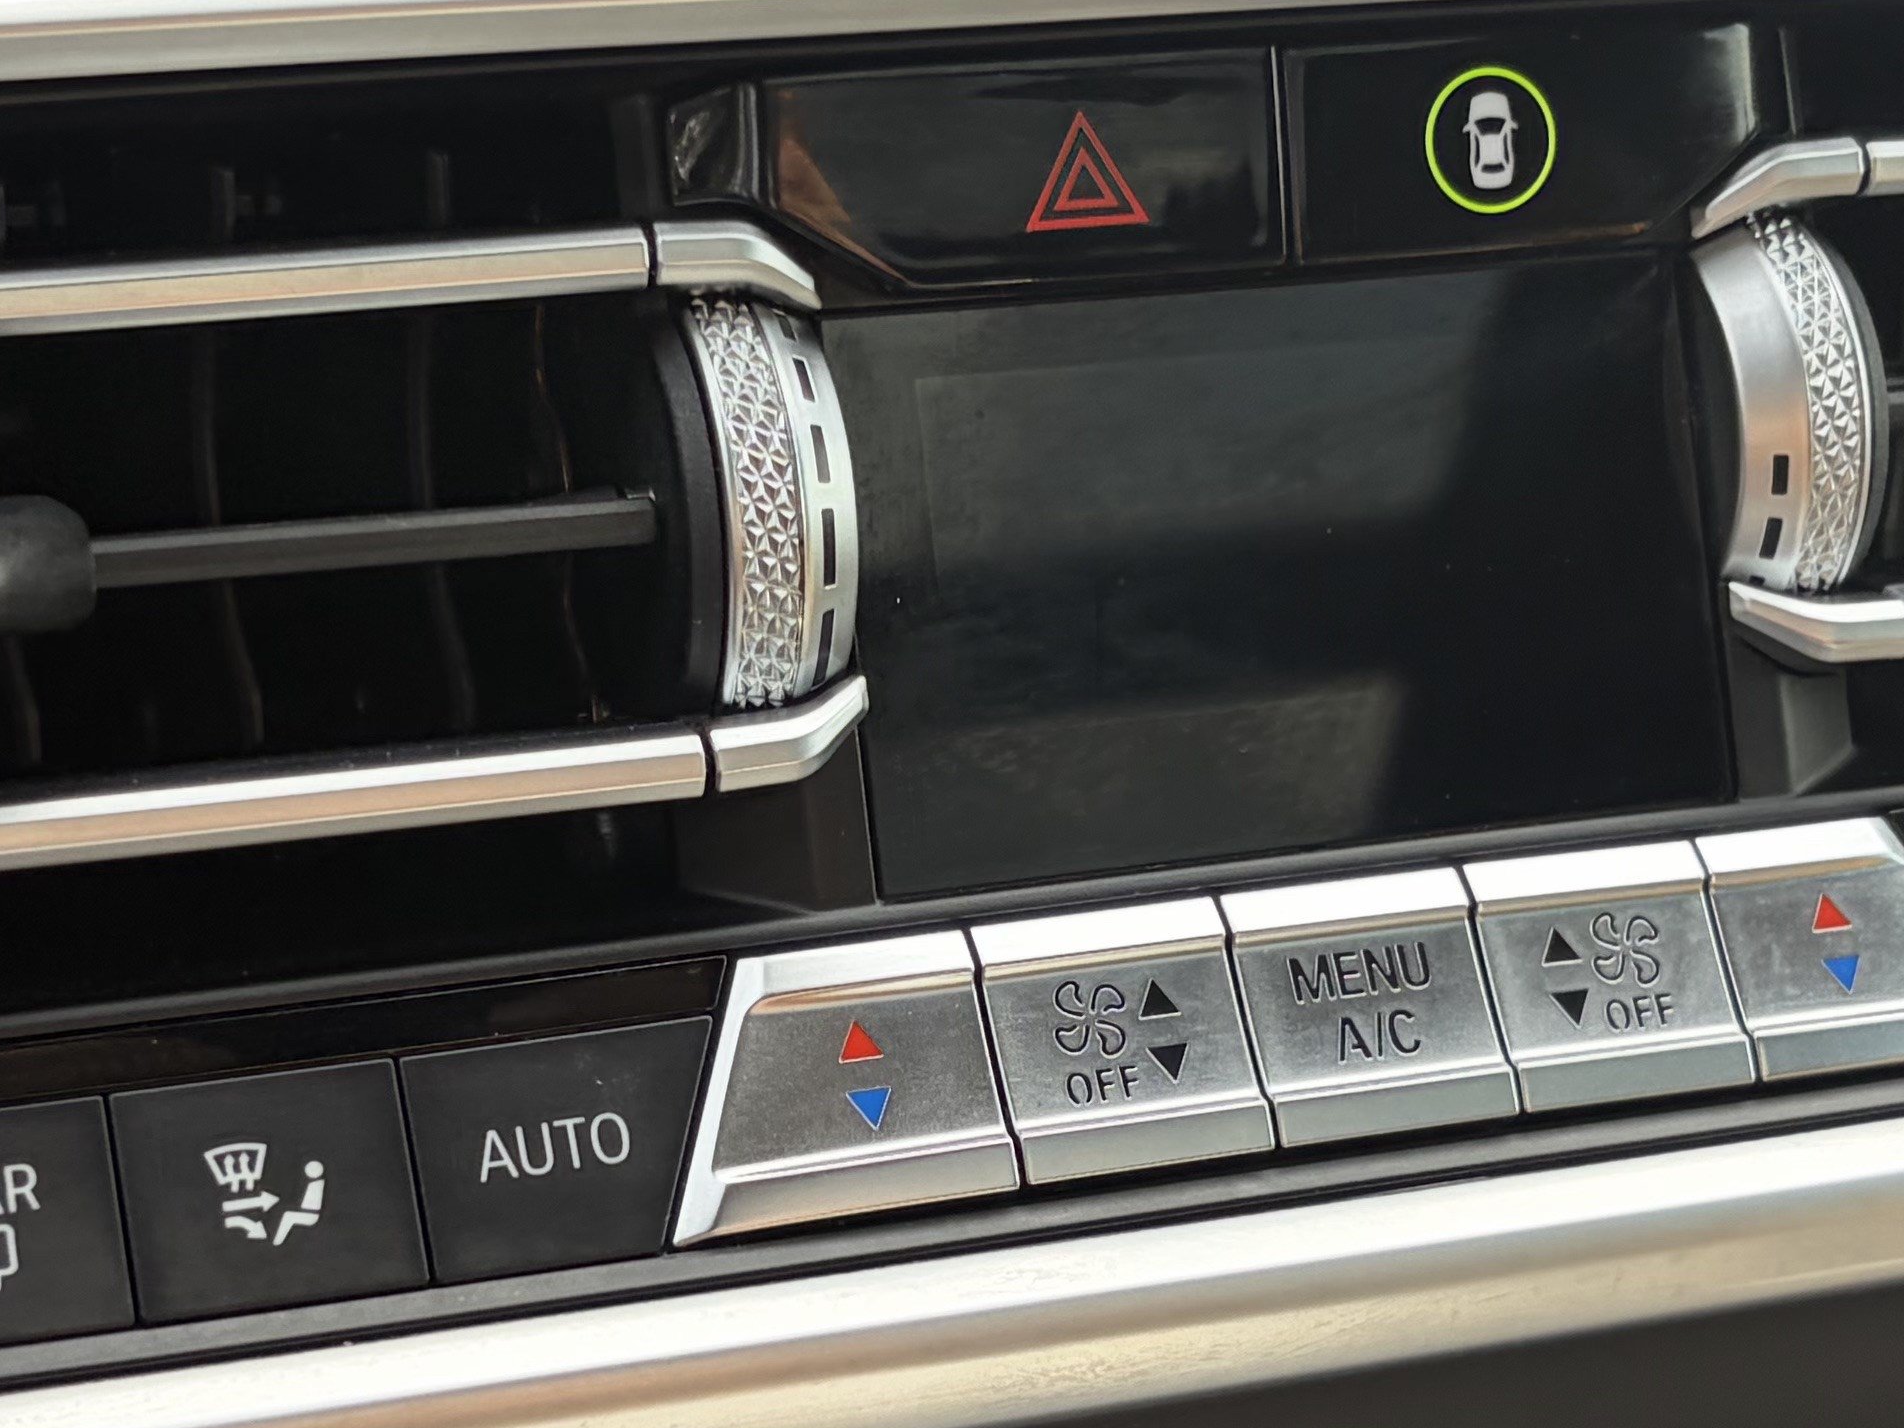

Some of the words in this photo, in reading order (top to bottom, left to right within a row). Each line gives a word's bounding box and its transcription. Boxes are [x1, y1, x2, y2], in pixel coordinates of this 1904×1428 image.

[1286, 940, 1432, 1006] MENU
[1338, 1008, 1421, 1064] A/C
[1604, 992, 1676, 1033] OFF
[1064, 1066, 1140, 1107] OFF
[480, 1111, 630, 1183] AUTO
